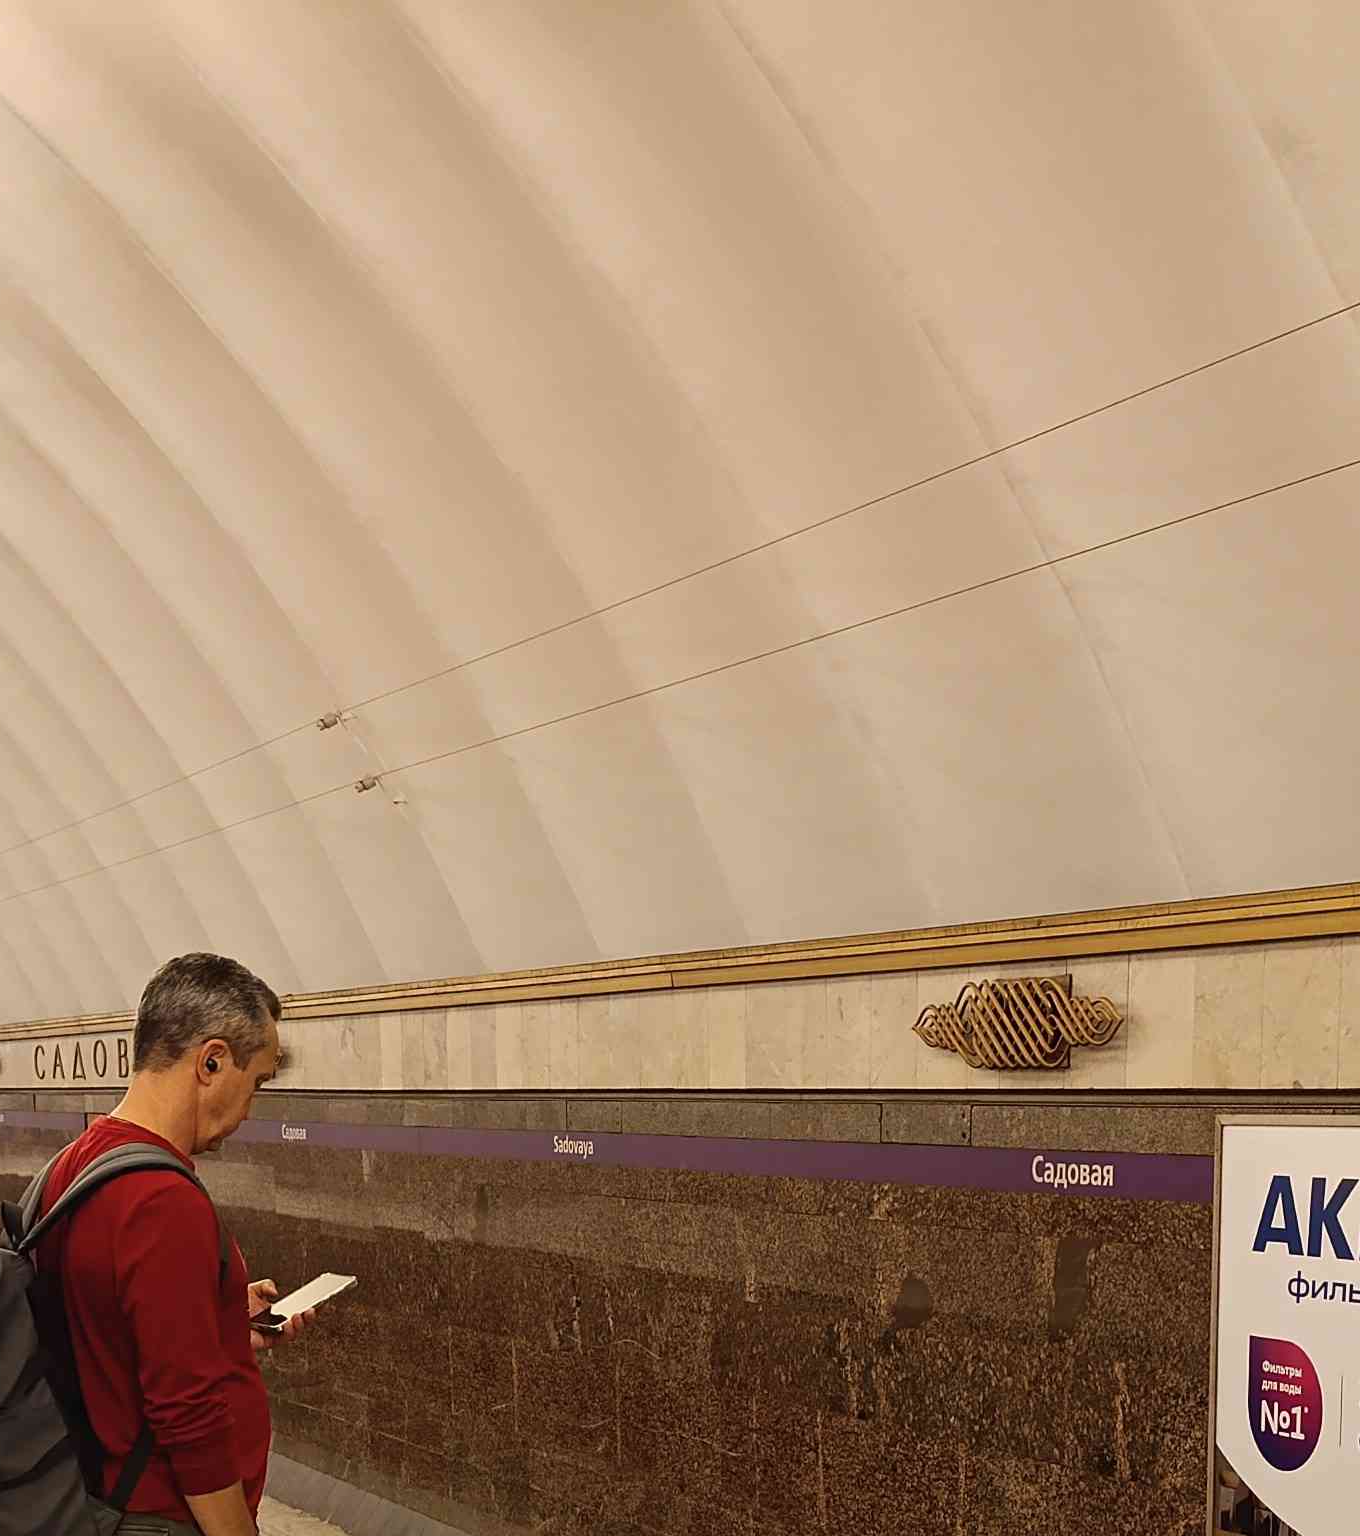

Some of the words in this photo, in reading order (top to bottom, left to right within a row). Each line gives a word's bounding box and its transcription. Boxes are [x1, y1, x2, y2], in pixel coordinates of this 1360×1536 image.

[281, 1123, 307, 1142] Садовая
[553, 1135, 595, 1159] Sadovaya
[1032, 1155, 1114, 1189] Садовая
[1262, 1360, 1302, 1379] Фильтры
[1262, 1380, 1278, 1392] для
[1279, 1382, 1302, 1396] воды
